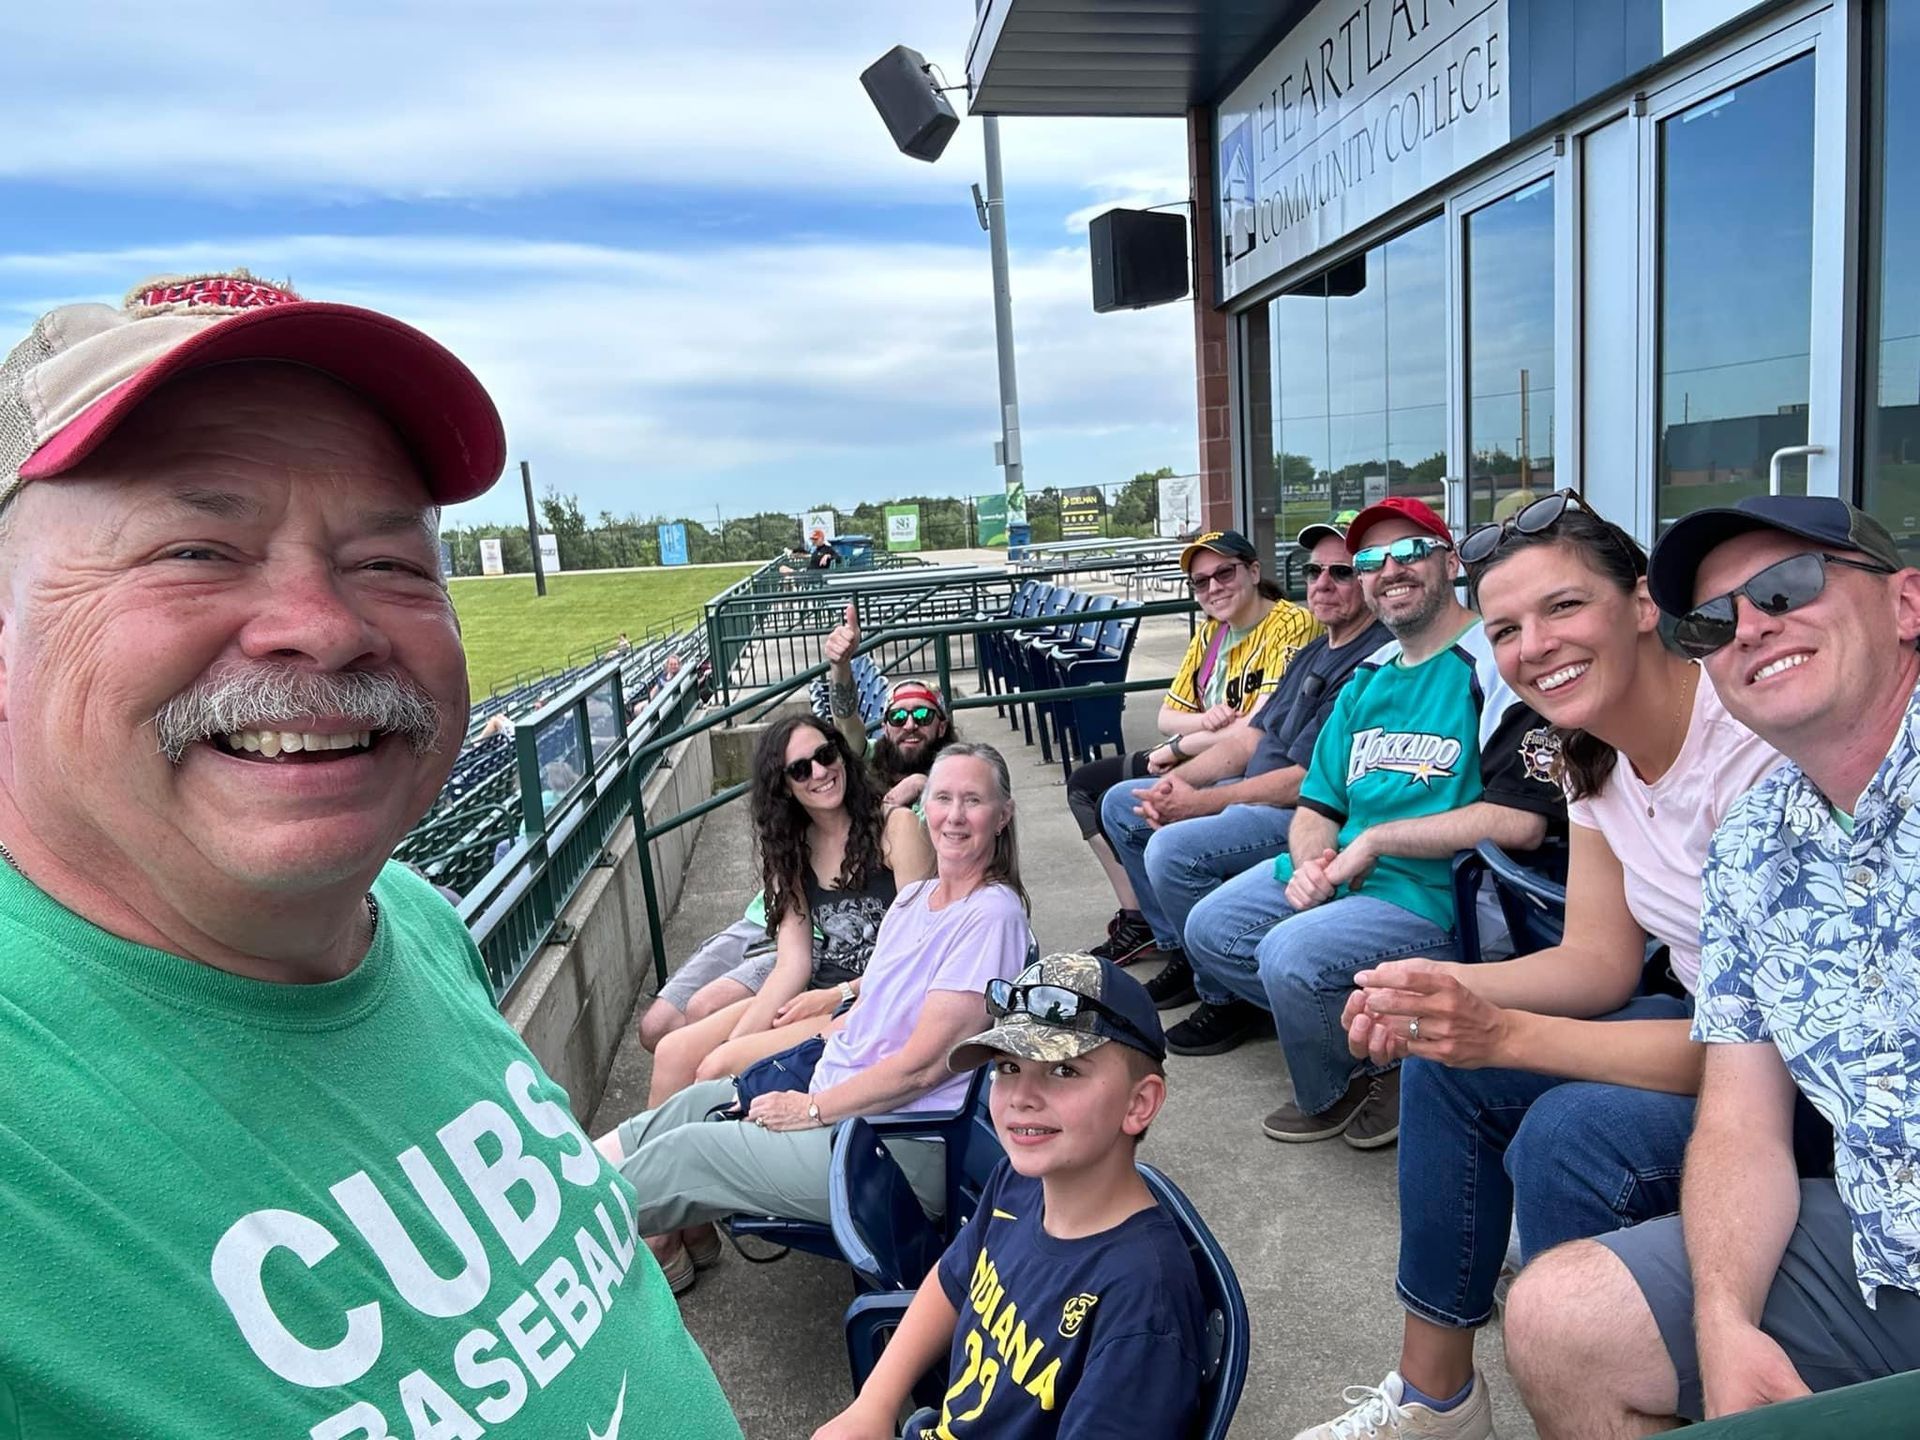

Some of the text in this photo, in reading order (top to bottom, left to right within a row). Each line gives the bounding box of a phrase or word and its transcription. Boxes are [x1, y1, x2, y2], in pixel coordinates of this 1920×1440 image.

[1260, 33, 1500, 243] COMMUNITY COLLEGE
[1345, 726, 1462, 787] HOKKAIDO
[211, 1060, 600, 1388] CUBS
[970, 1247, 1062, 1411] NDIANA
